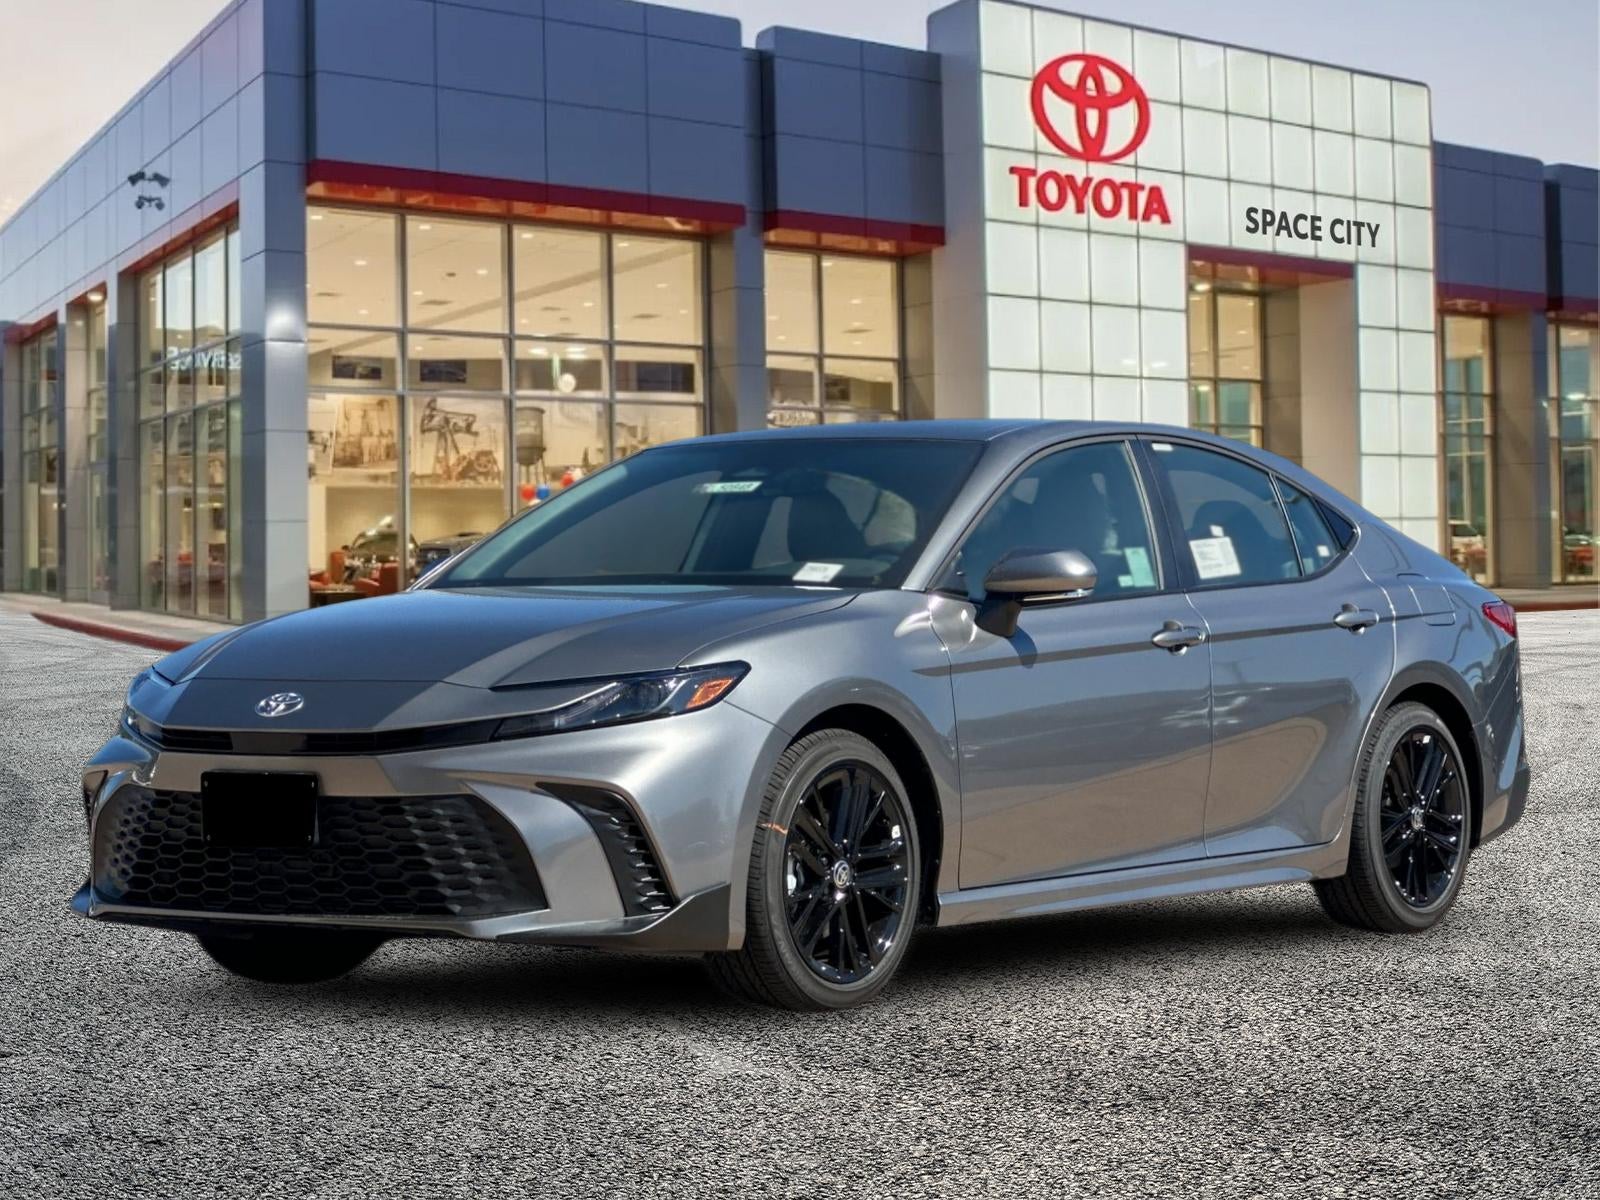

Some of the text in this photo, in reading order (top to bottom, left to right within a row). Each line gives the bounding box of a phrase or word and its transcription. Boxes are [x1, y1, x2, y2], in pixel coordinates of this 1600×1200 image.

[1009, 166, 1171, 224] TOYOTA
[1245, 207, 1381, 248] SPACE CITY
